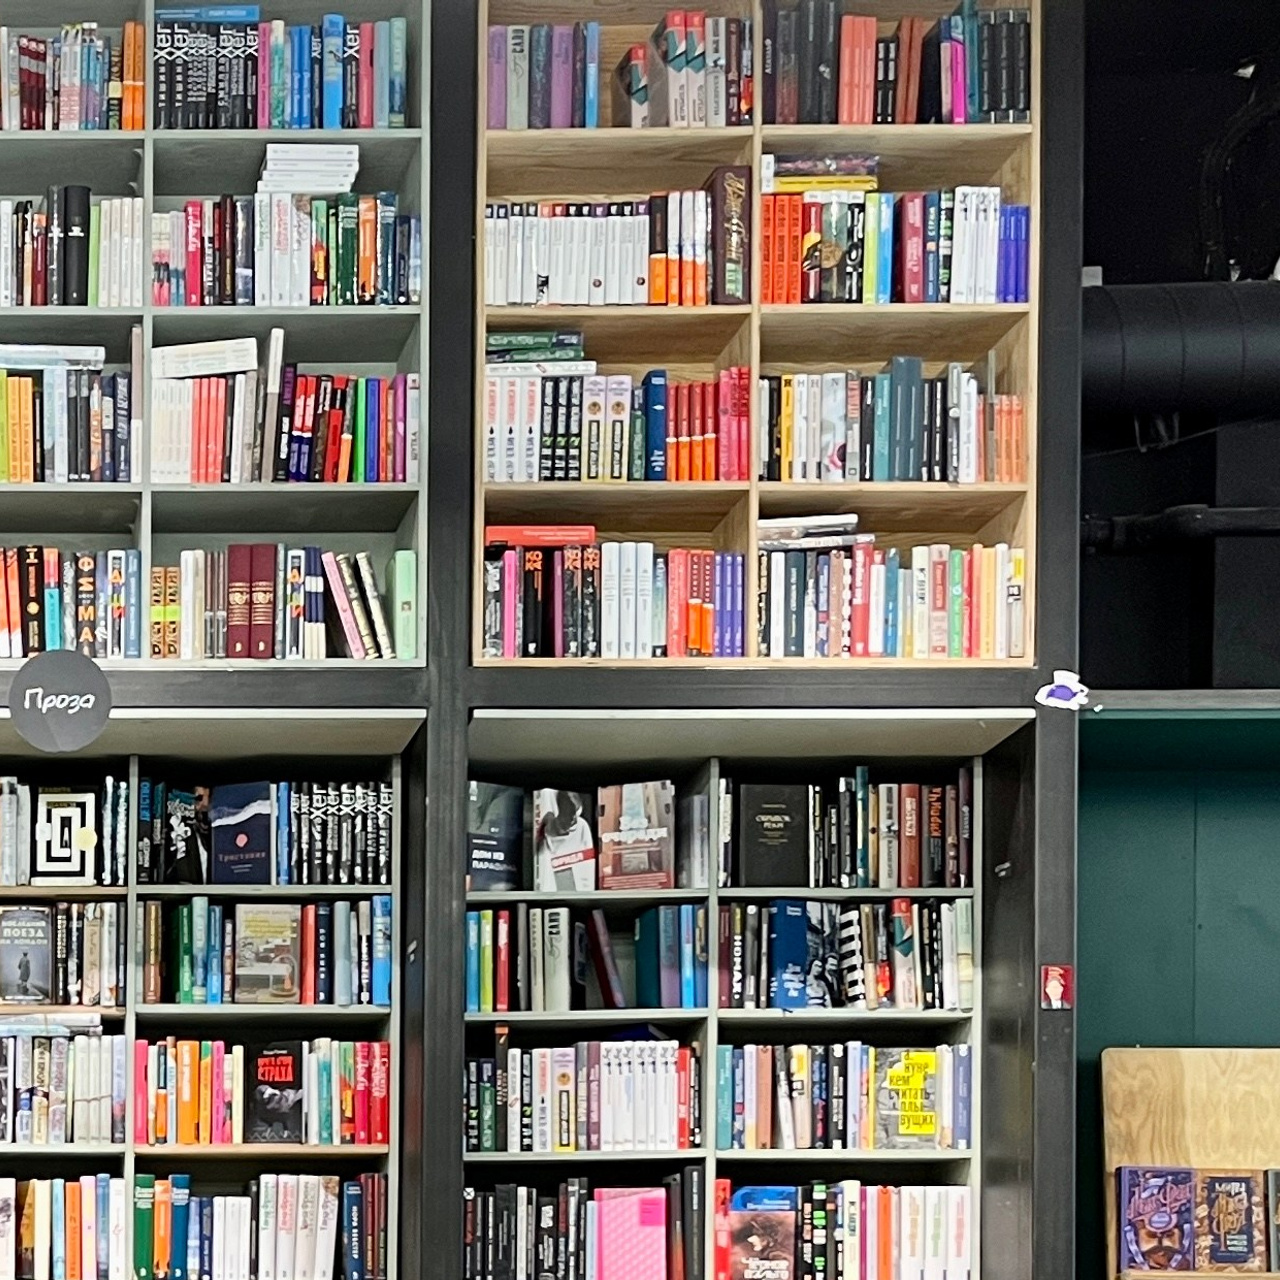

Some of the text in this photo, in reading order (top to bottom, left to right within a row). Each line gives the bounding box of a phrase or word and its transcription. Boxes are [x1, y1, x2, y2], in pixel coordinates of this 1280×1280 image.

[410, 432, 418, 460] ШУТКА
[23, 688, 95, 714] Проза
[140, 781, 151, 821] ДЕТСТВО
[3, 929, 45, 939] ПОЕЗД
[890, 1076, 910, 1086] кем
[900, 1112, 934, 1127] вущих
